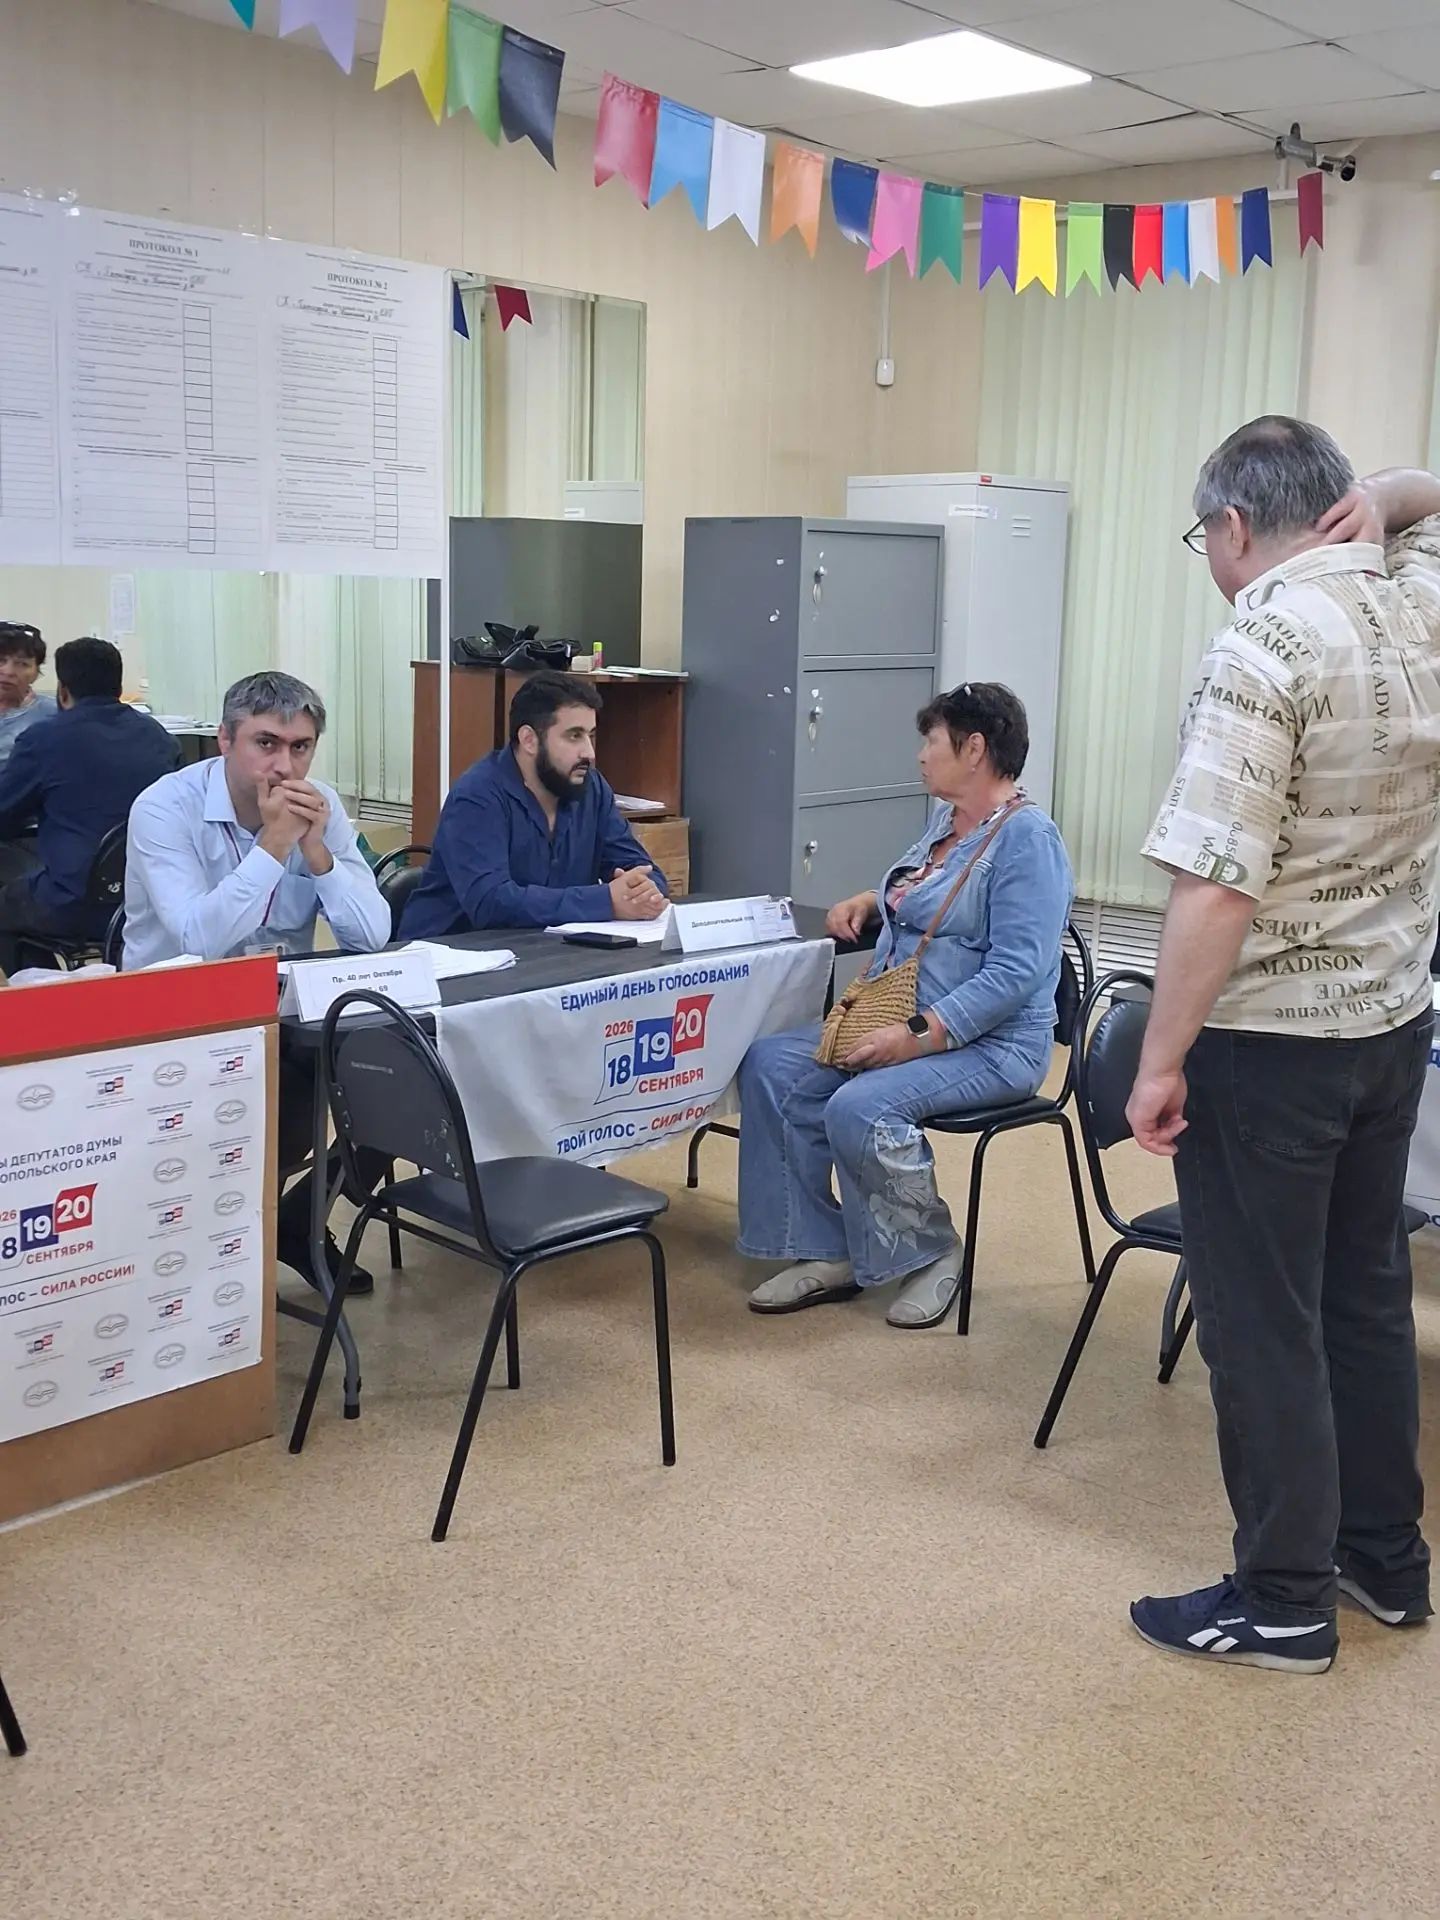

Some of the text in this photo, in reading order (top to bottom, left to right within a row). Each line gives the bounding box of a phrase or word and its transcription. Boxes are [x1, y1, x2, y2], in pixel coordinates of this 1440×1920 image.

[129, 238, 182, 255] ПРОТОКОЛ
[327, 272, 373, 288] ПРОТОКОЛ
[1258, 954, 1365, 977] MADISON
[561, 964, 749, 1011] ЕДИНЫЙ ДЕНЬ ГОЛОСОВАНИЯ
[1275, 1004, 1341, 1019] Avenue
[605, 1019, 634, 1038] 2026
[607, 1007, 702, 1087] 18 19 20
[638, 1067, 704, 1094] СЕНТЯБРЯ
[10, 1143, 83, 1168] ДЕПУТАТОВ
[86, 1136, 123, 1153] ДУМЫ
[556, 1130, 586, 1155] ТВОЙ
[588, 1123, 635, 1146] ГОЛОС
[86, 1151, 117, 1166] КРАЯ
[23, 1215, 52, 1242] 19
[56, 1195, 91, 1224] 20
[26, 1240, 94, 1265] СЕНТЯБРЯ
[41, 1279, 77, 1296] СИЛА
[80, 1264, 135, 1287] РОССИИ!
